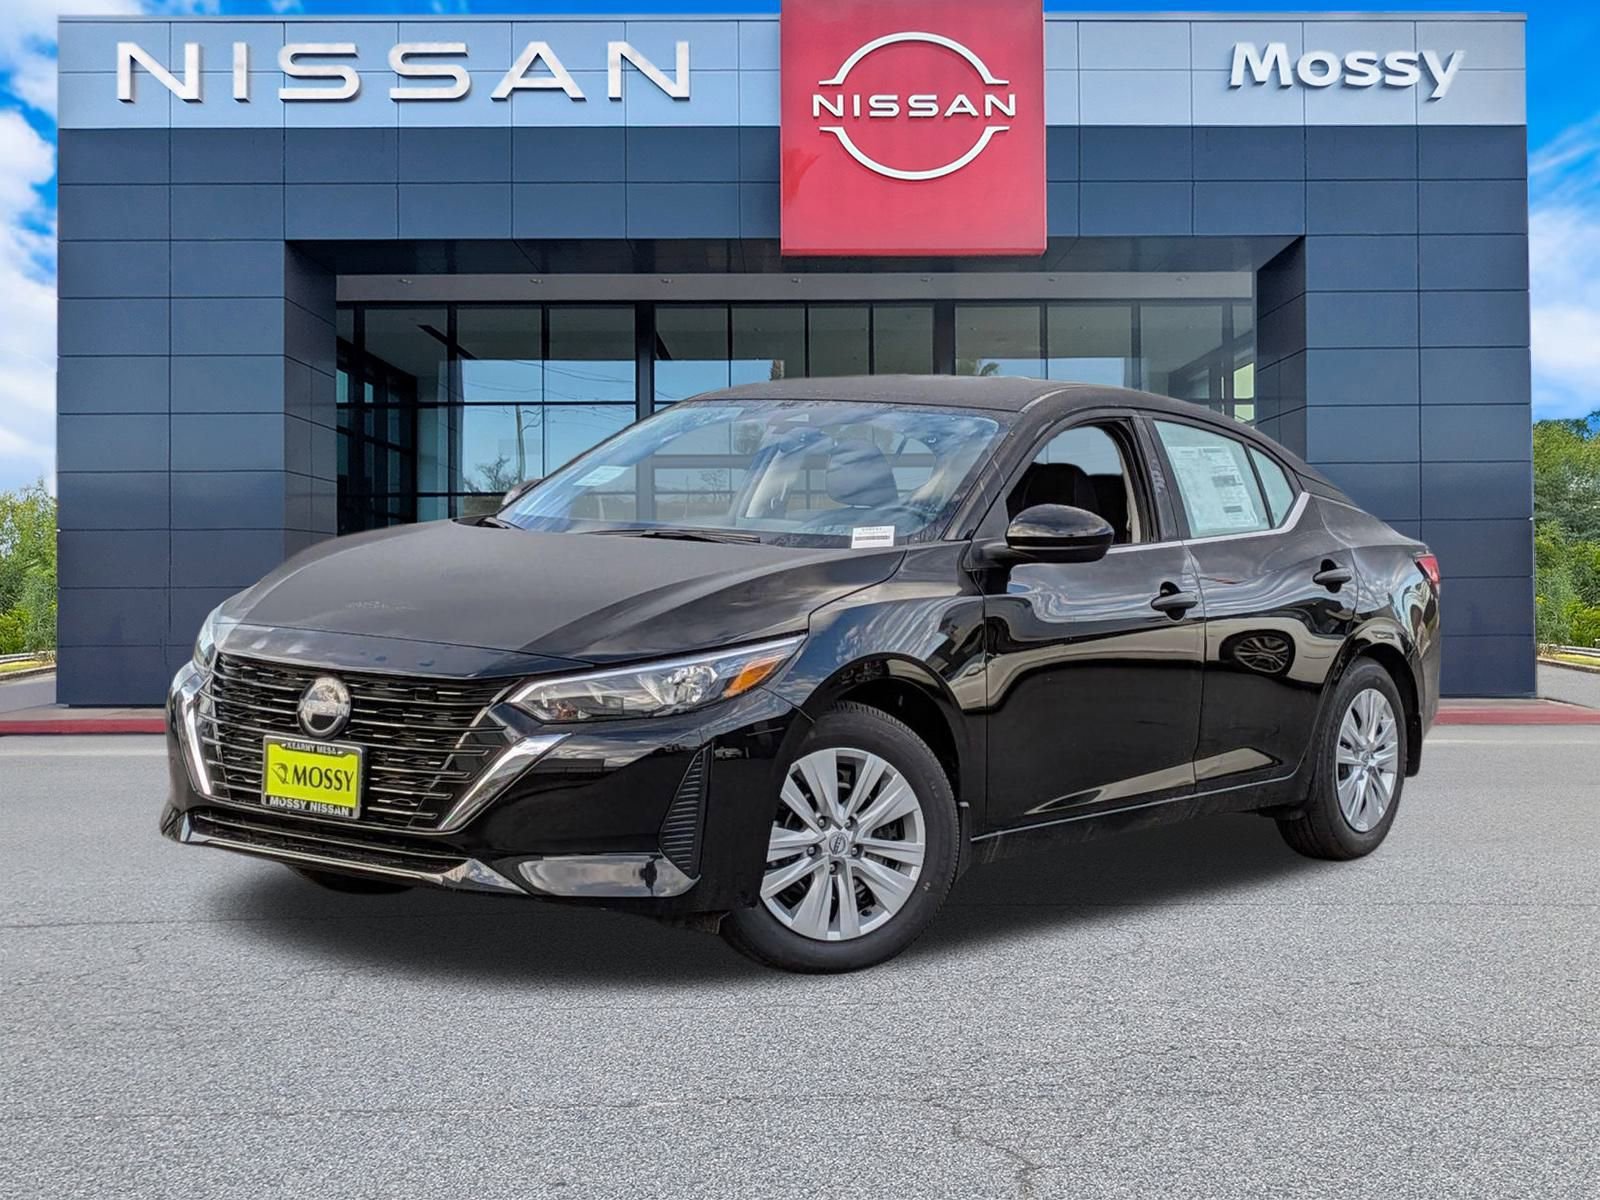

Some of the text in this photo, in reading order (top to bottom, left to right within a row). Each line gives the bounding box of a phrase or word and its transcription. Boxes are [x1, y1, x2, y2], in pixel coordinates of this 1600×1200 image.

[116, 41, 691, 102] NISSAN
[1229, 41, 1466, 101] Mossy
[812, 93, 1017, 118] NISSAN
[286, 742, 337, 755] KEARNY MESA
[292, 764, 355, 793] MOSSY
[269, 796, 349, 817] MOSSY NISSAN
